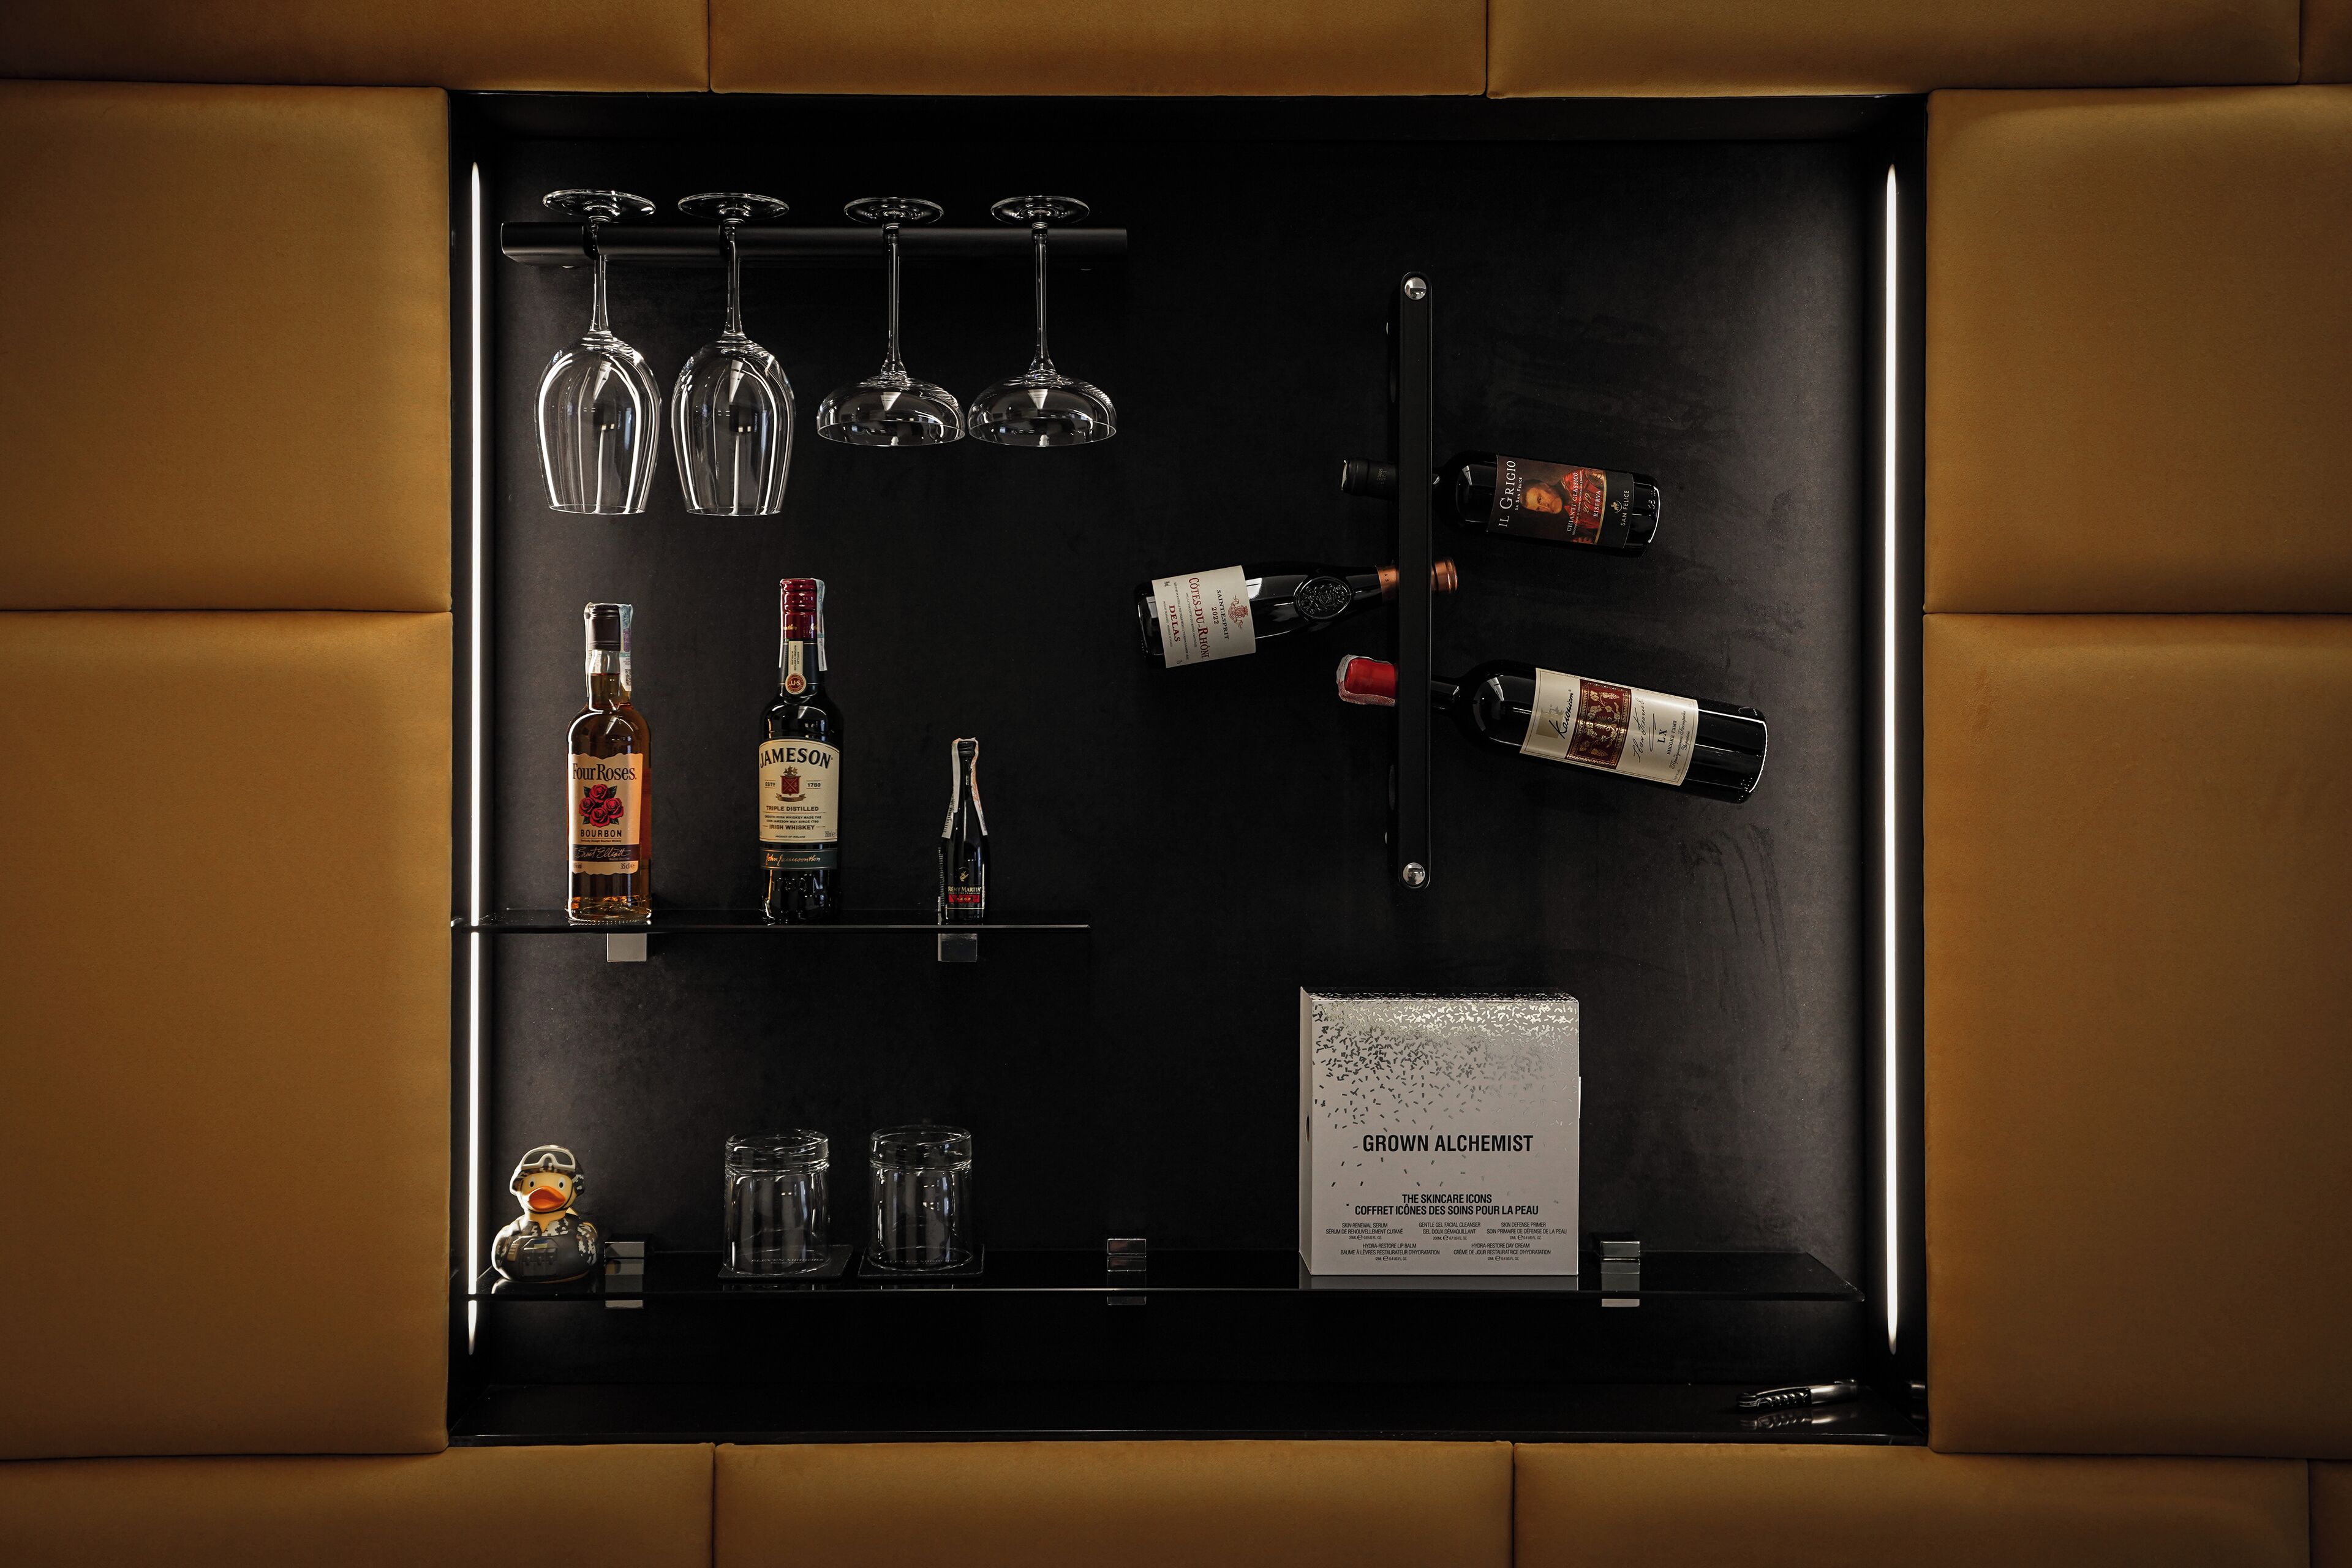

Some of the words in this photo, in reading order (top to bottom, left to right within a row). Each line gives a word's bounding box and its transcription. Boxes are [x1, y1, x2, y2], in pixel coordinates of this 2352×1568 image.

[1499, 460, 1516, 510] GRIGIO
[1583, 493, 1592, 514] 2019
[1498, 515, 1510, 527] IL
[1567, 504, 1576, 532] CHIANTI
[1169, 605, 1180, 642] DELAS
[760, 748, 831, 769] JAMESON
[573, 763, 596, 779] Four
[1363, 1134, 1428, 1152] GROWN
[1434, 1134, 1534, 1152] ALCHEMIST
[1402, 1194, 1419, 1204] THE
[1420, 1194, 1464, 1204] SKINCARE
[1466, 1194, 1492, 1204] ICONS
[1355, 1206, 1393, 1215] COFFRET
[1395, 1204, 1427, 1215] ICÔNES
[1429, 1206, 1446, 1215] DES
[1448, 1206, 1473, 1215] SOINS
[1476, 1206, 1500, 1215] POUR
[1502, 1206, 1513, 1215] LA
[1515, 1206, 1539, 1215] PEAU
